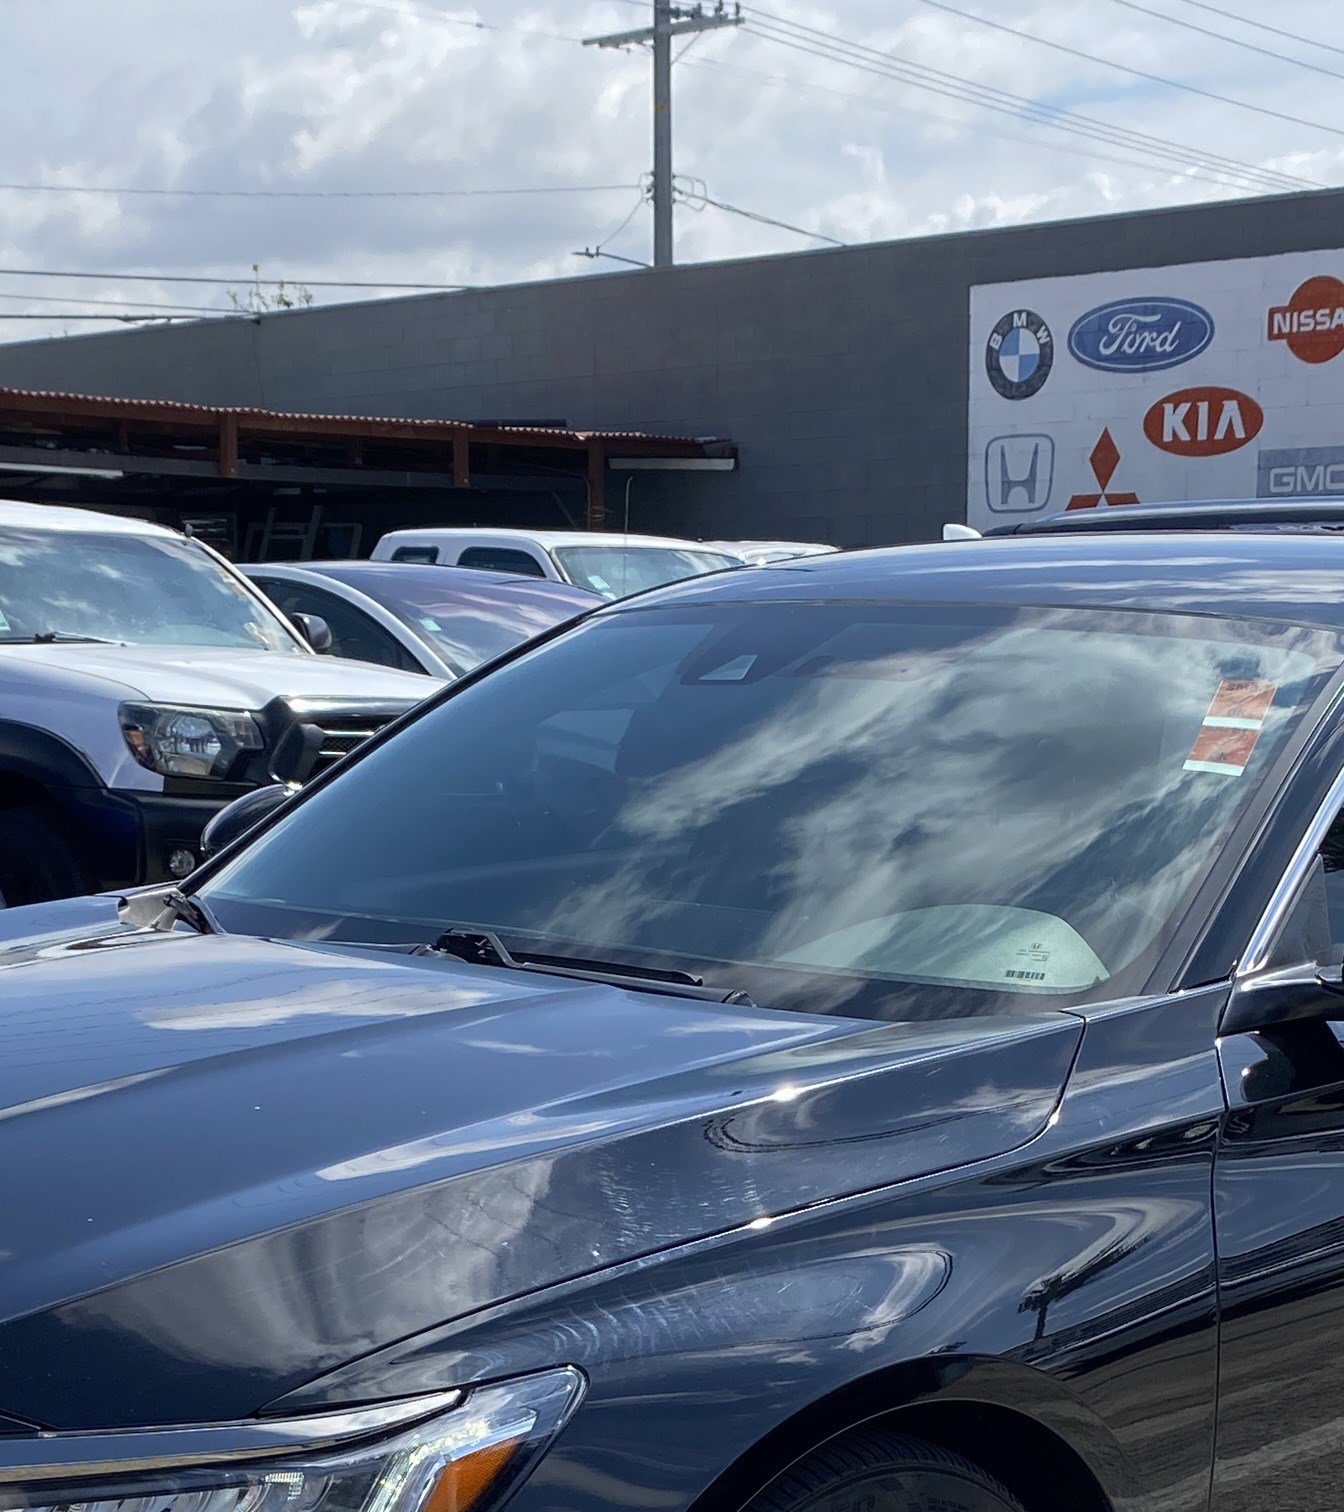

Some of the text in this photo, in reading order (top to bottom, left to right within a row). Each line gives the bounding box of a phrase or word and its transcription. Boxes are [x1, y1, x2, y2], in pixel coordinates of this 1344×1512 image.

[989, 311, 1051, 351] BMW
[1098, 313, 1182, 356] Ford
[1162, 399, 1246, 443] KIA
